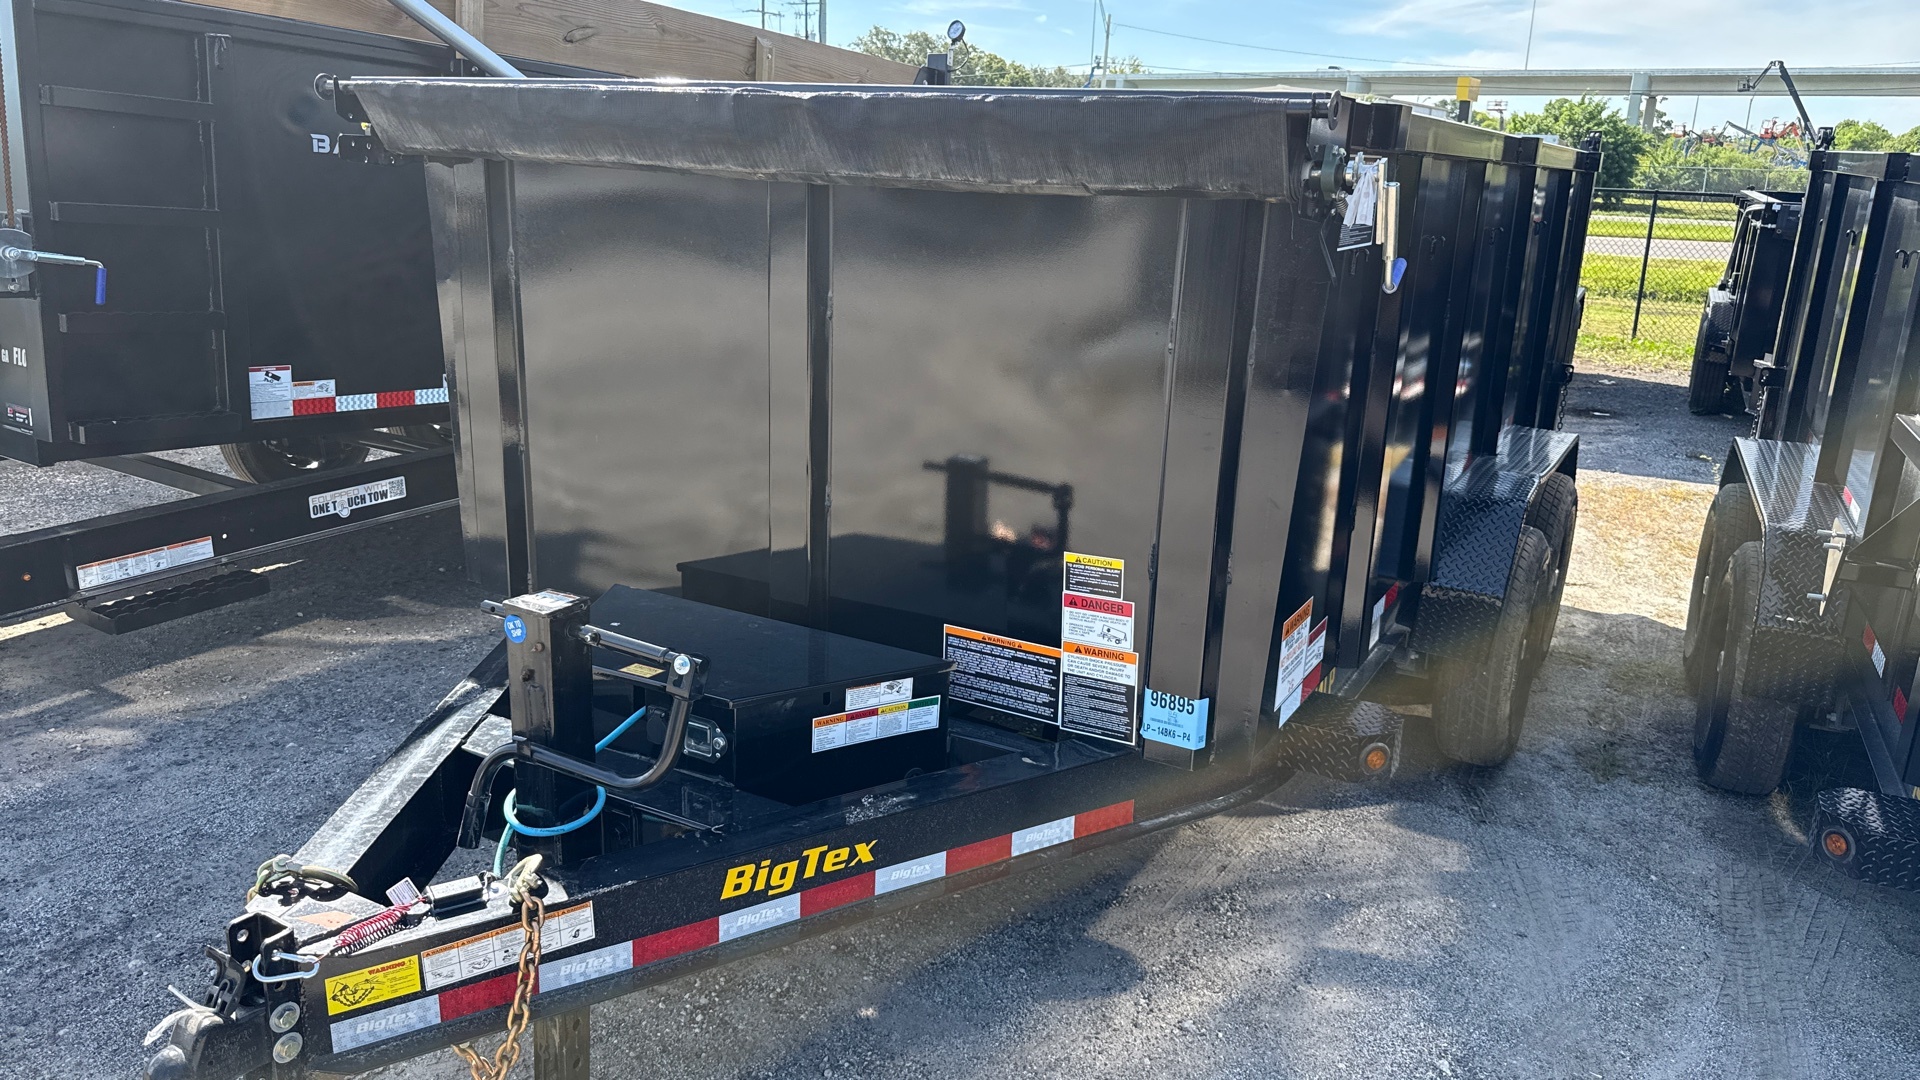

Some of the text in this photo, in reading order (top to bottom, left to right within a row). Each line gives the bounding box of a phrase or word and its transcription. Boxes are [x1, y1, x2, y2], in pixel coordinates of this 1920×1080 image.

[312, 482, 388, 505] EQUIPPED WITH
[312, 502, 331, 516] ONE
[367, 489, 389, 503] TOW
[1082, 557, 1113, 567] CAUTION
[1081, 599, 1124, 614] DANGER
[506, 619, 522, 630] OK TO
[511, 628, 522, 638] SHIP
[987, 636, 1016, 648] WARNING
[1083, 646, 1125, 661] WARNING
[884, 705, 907, 713] CAUTION
[1150, 690, 1195, 715] 96895
[816, 717, 844, 726] WARNING
[1025, 827, 1063, 843] BigTex
[720, 839, 878, 901] BigTex
[890, 863, 932, 881] BigTex
[736, 905, 784, 927] BigTex
[367, 960, 406, 976] WARNING
[559, 954, 614, 976] BigTex
[355, 1009, 417, 1034] BigTex
